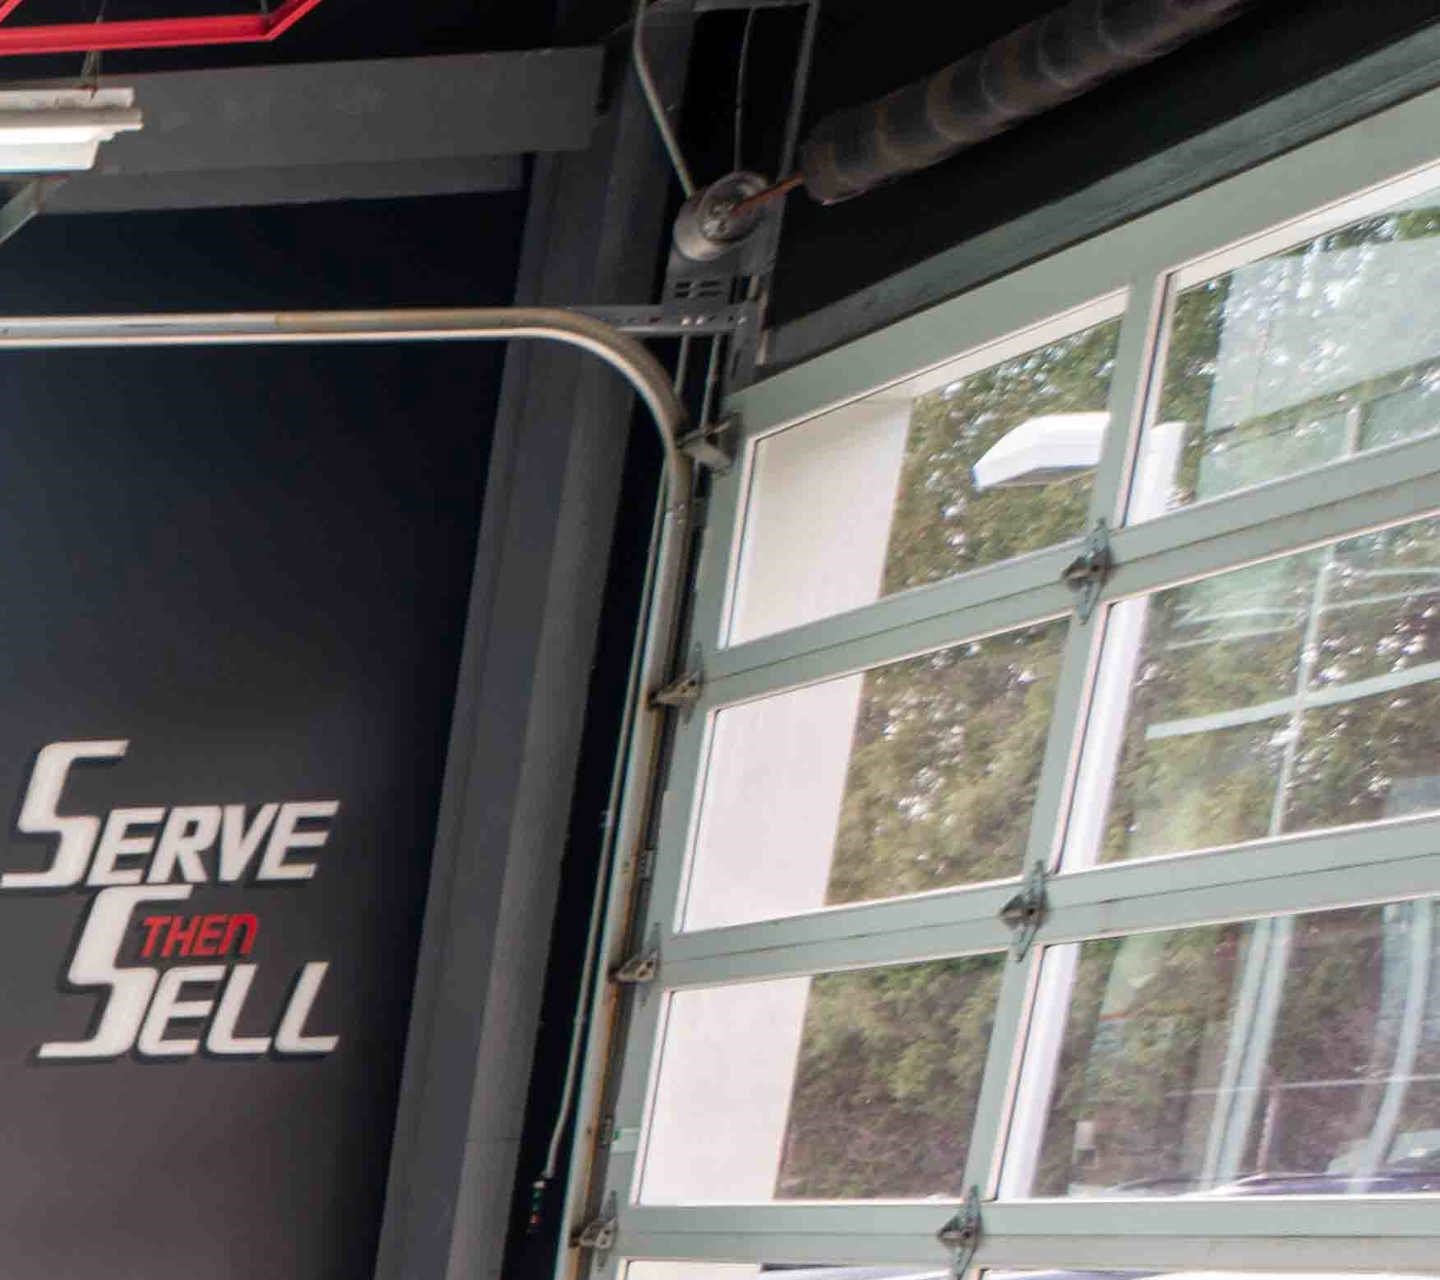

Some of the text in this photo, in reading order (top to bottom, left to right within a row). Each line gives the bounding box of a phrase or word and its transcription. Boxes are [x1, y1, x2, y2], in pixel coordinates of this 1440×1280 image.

[0, 739, 340, 888] SERVE
[37, 884, 340, 1058] SELL
[139, 912, 258, 958] THEN
